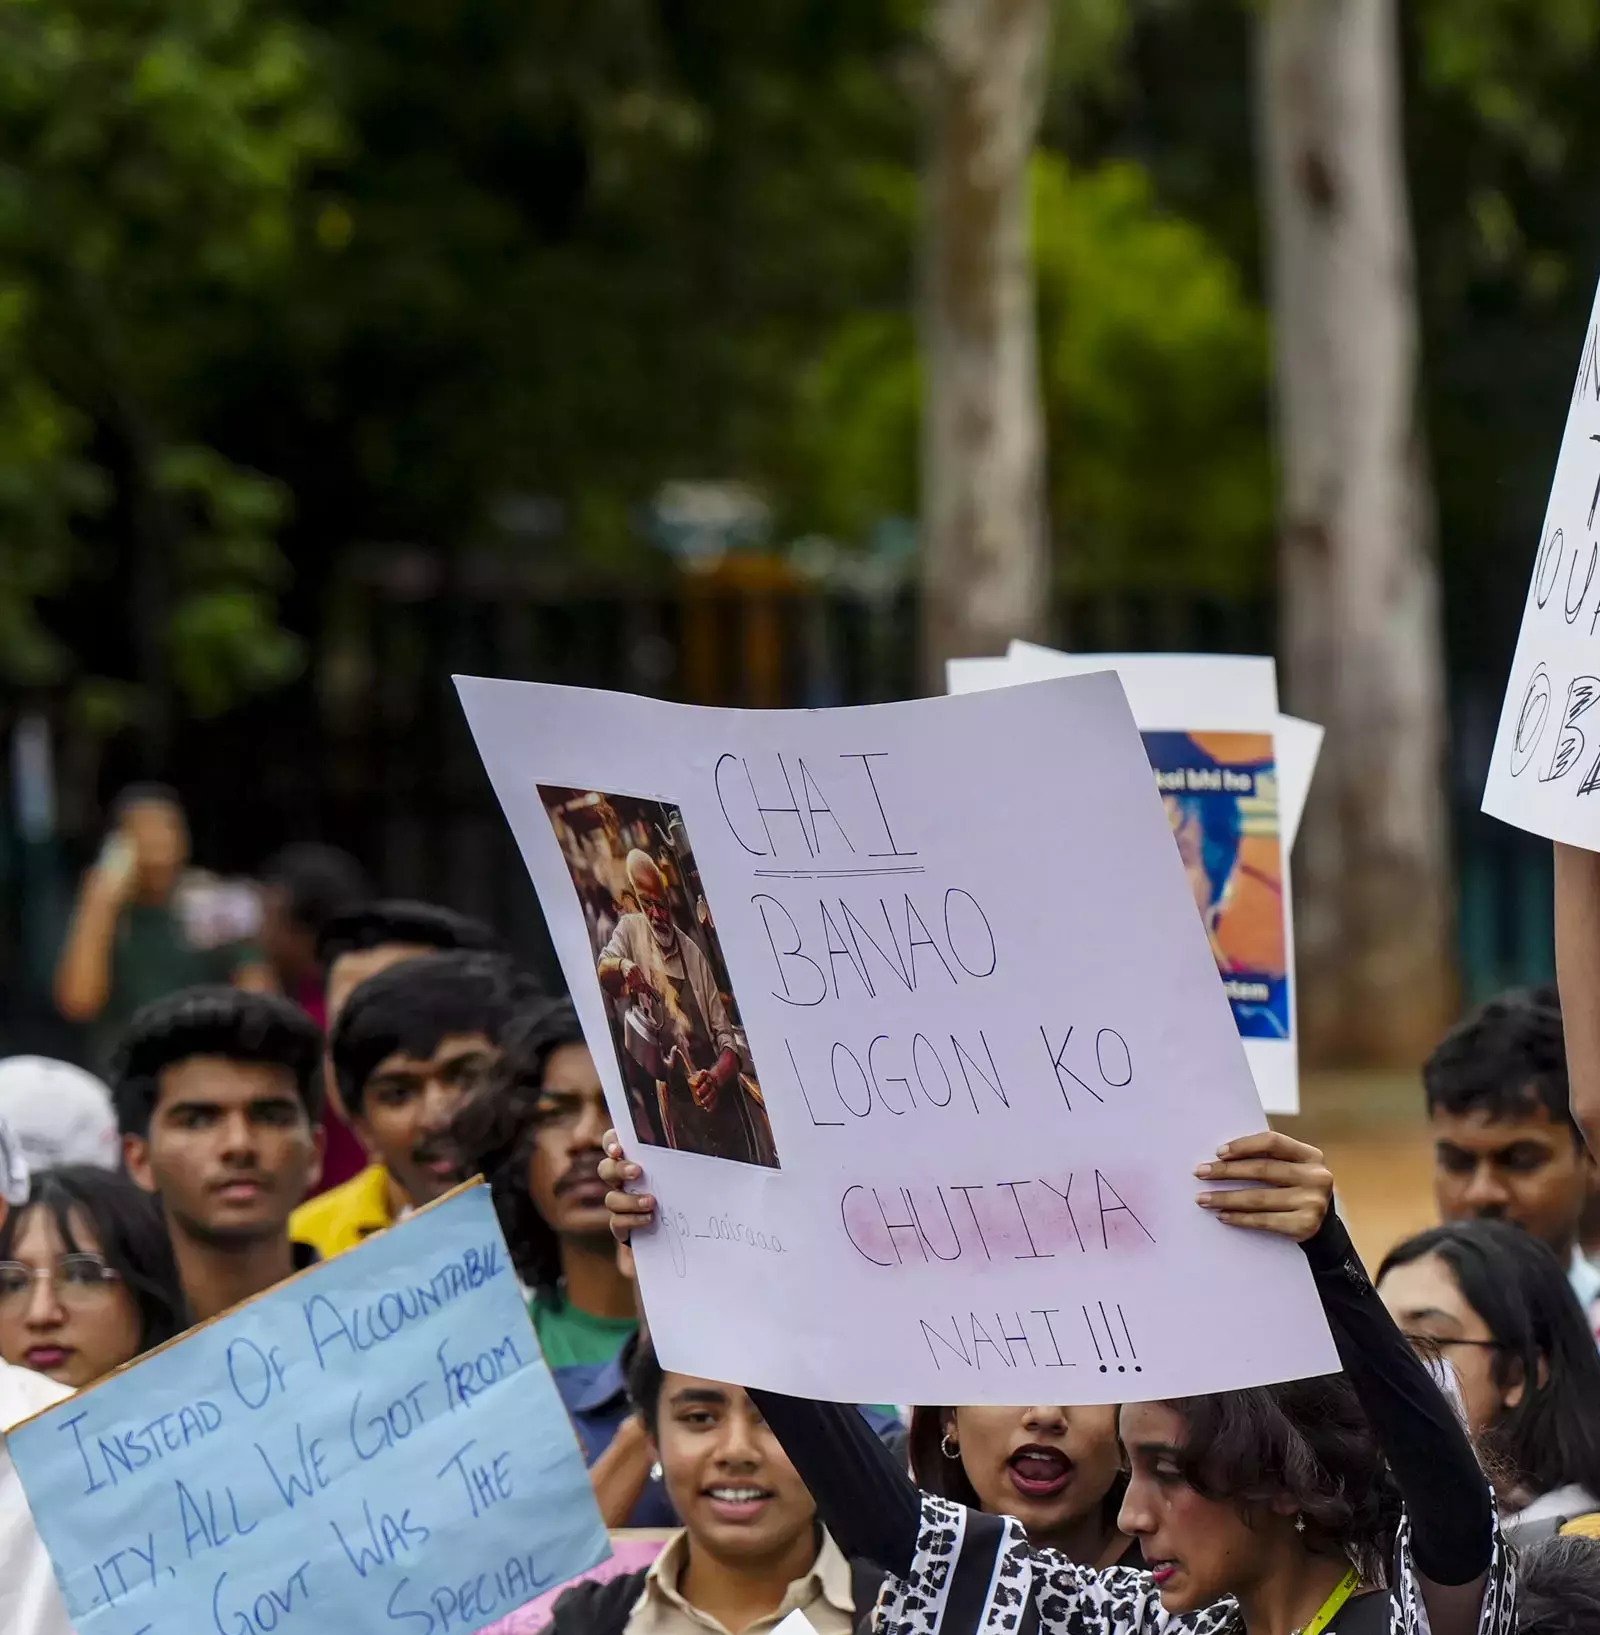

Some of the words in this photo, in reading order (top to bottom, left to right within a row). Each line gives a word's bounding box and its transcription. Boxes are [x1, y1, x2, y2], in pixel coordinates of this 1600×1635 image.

[714, 752, 917, 857] CHAI
[750, 887, 997, 1007] BANAO
[783, 1028, 1011, 1127] LOGON
[1039, 1024, 1133, 1111] KO
[841, 1168, 1157, 1268] CHUTIYA
[57, 1399, 223, 1496] INSTEAD
[226, 1336, 288, 1410] OF
[174, 1479, 258, 1560] ALL
[254, 1421, 331, 1509] WE
[349, 1380, 429, 1465] GOT
[437, 1336, 522, 1413] FROM
[330, 1498, 429, 1579] WAS
[436, 1438, 517, 1519] THE
